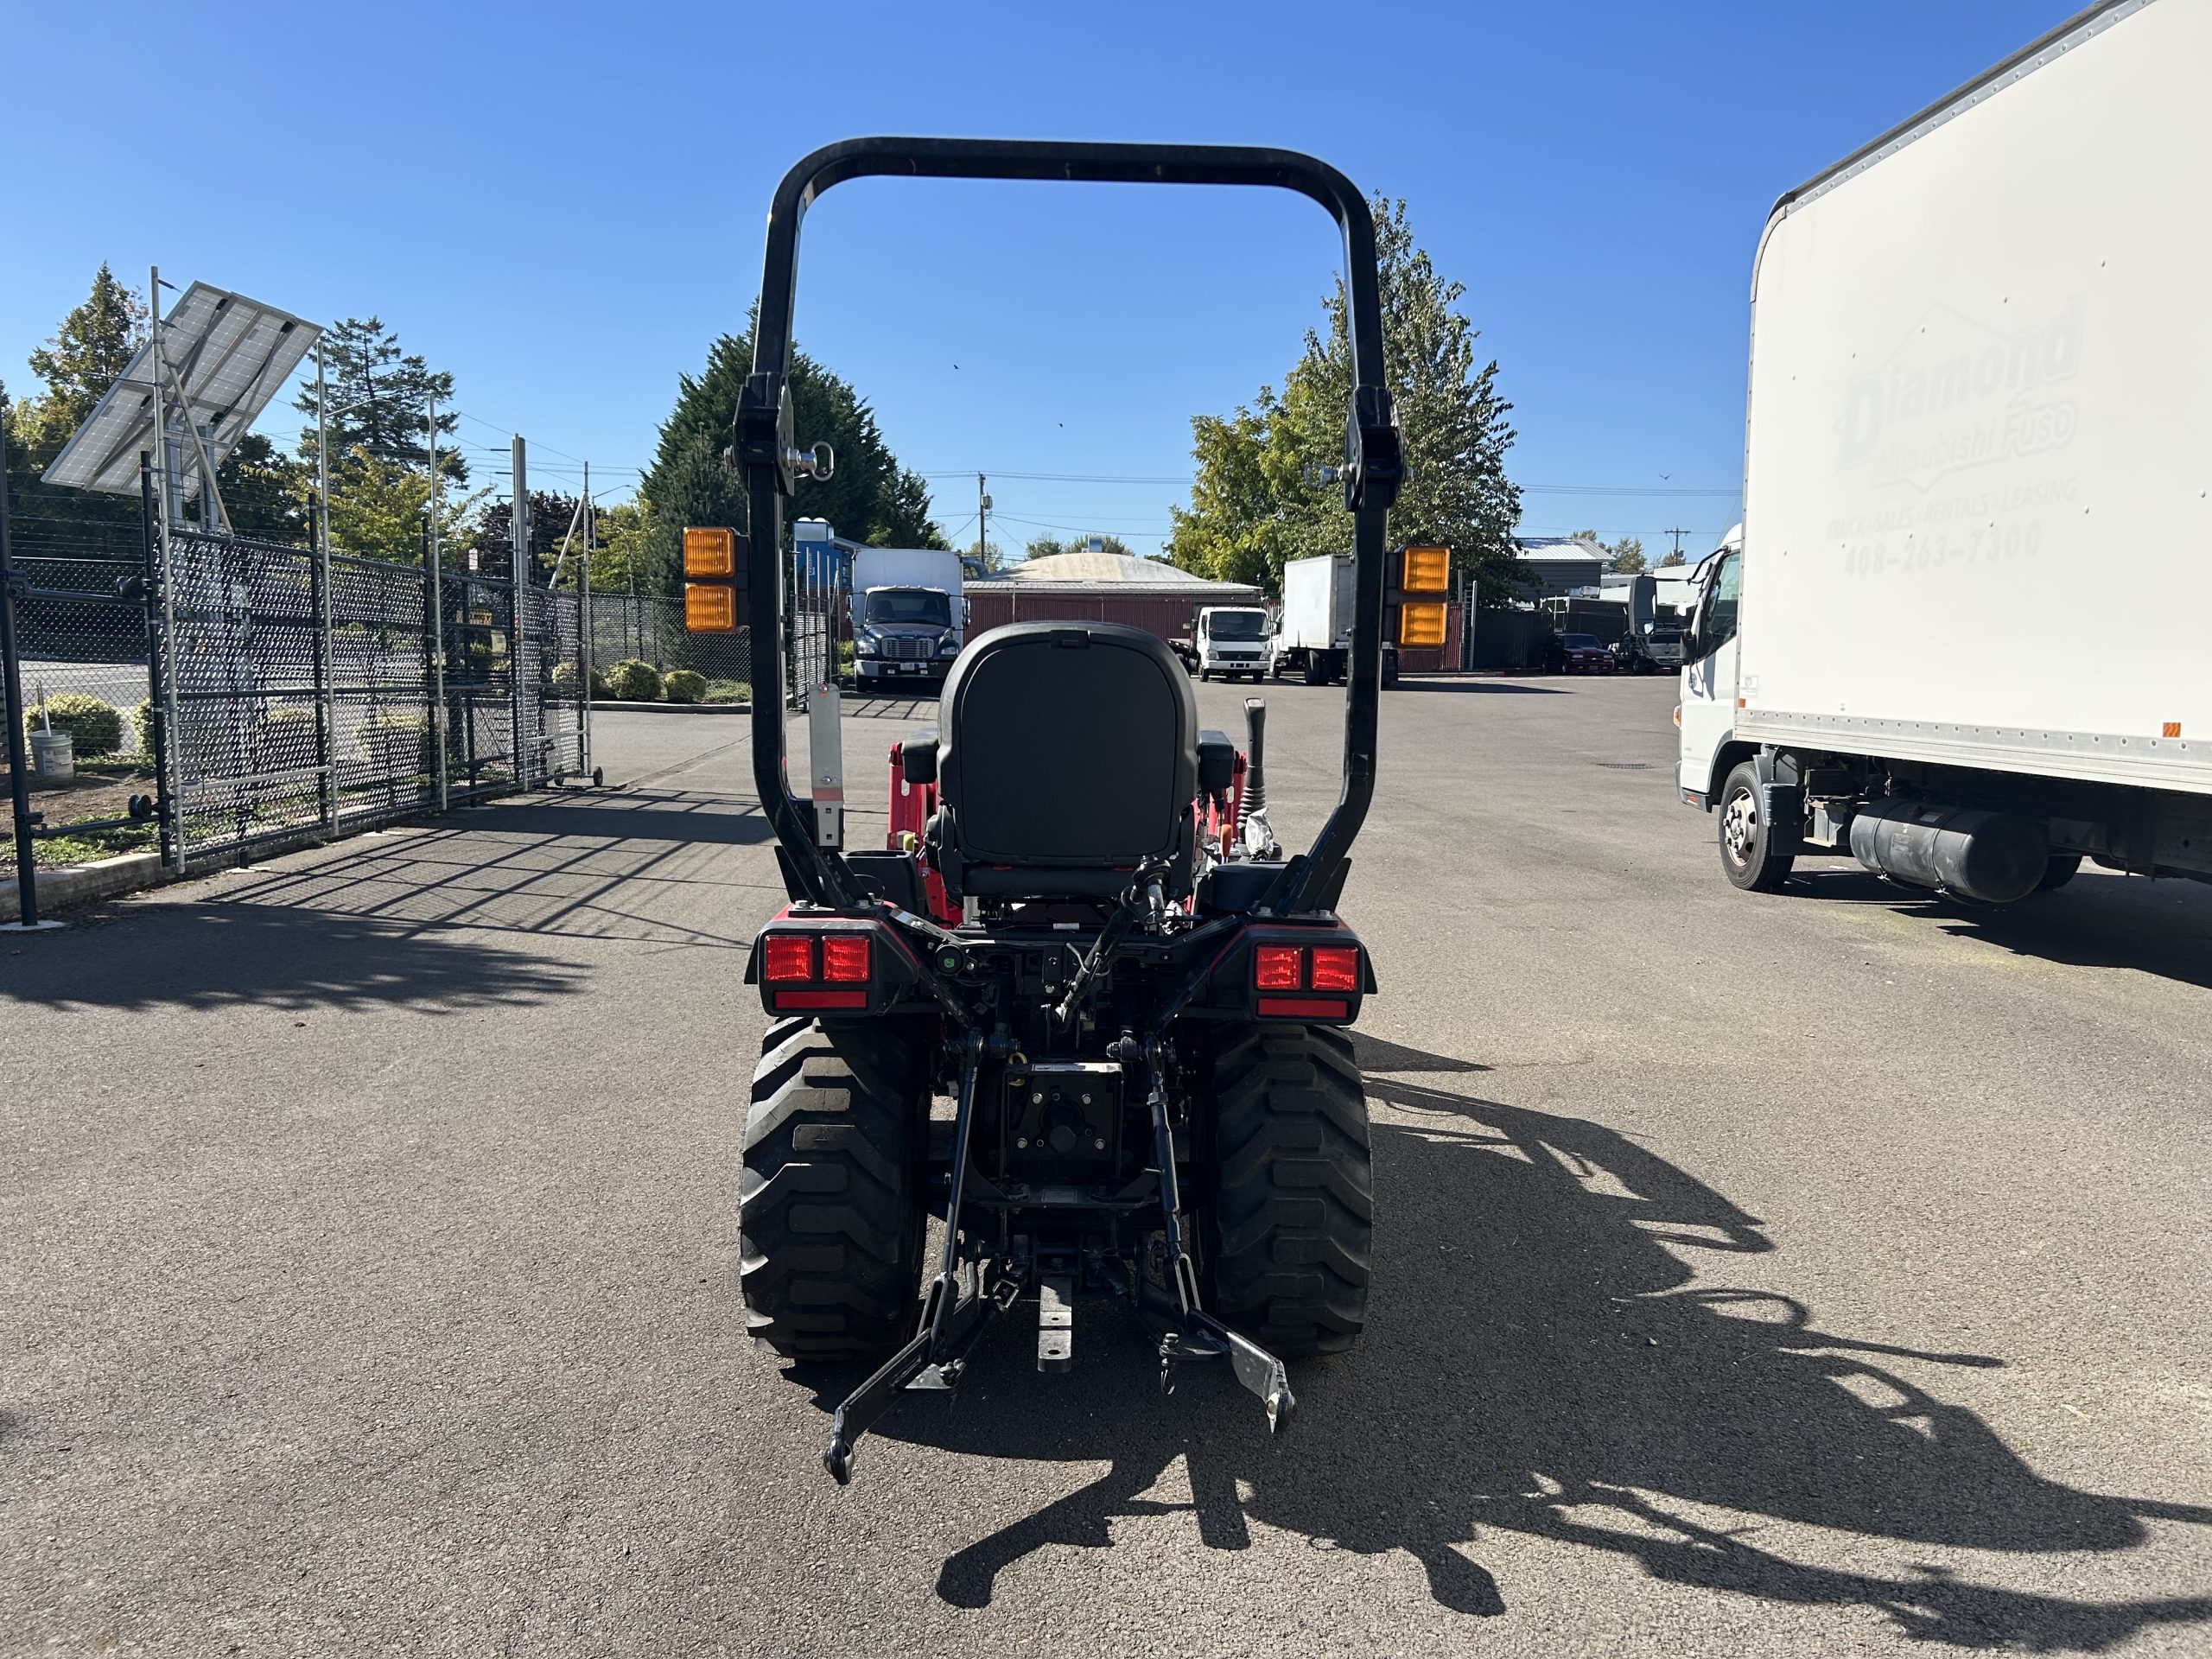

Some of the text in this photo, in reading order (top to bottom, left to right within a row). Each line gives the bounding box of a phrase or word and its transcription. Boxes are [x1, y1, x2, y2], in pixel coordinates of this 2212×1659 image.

[1838, 293, 2088, 467] Diamond
[2002, 410, 2071, 450] Fuso
[1827, 477, 2078, 540] TRUCK SALES RENTALS LEASING
[1844, 521, 2042, 578] 408-263-7300
